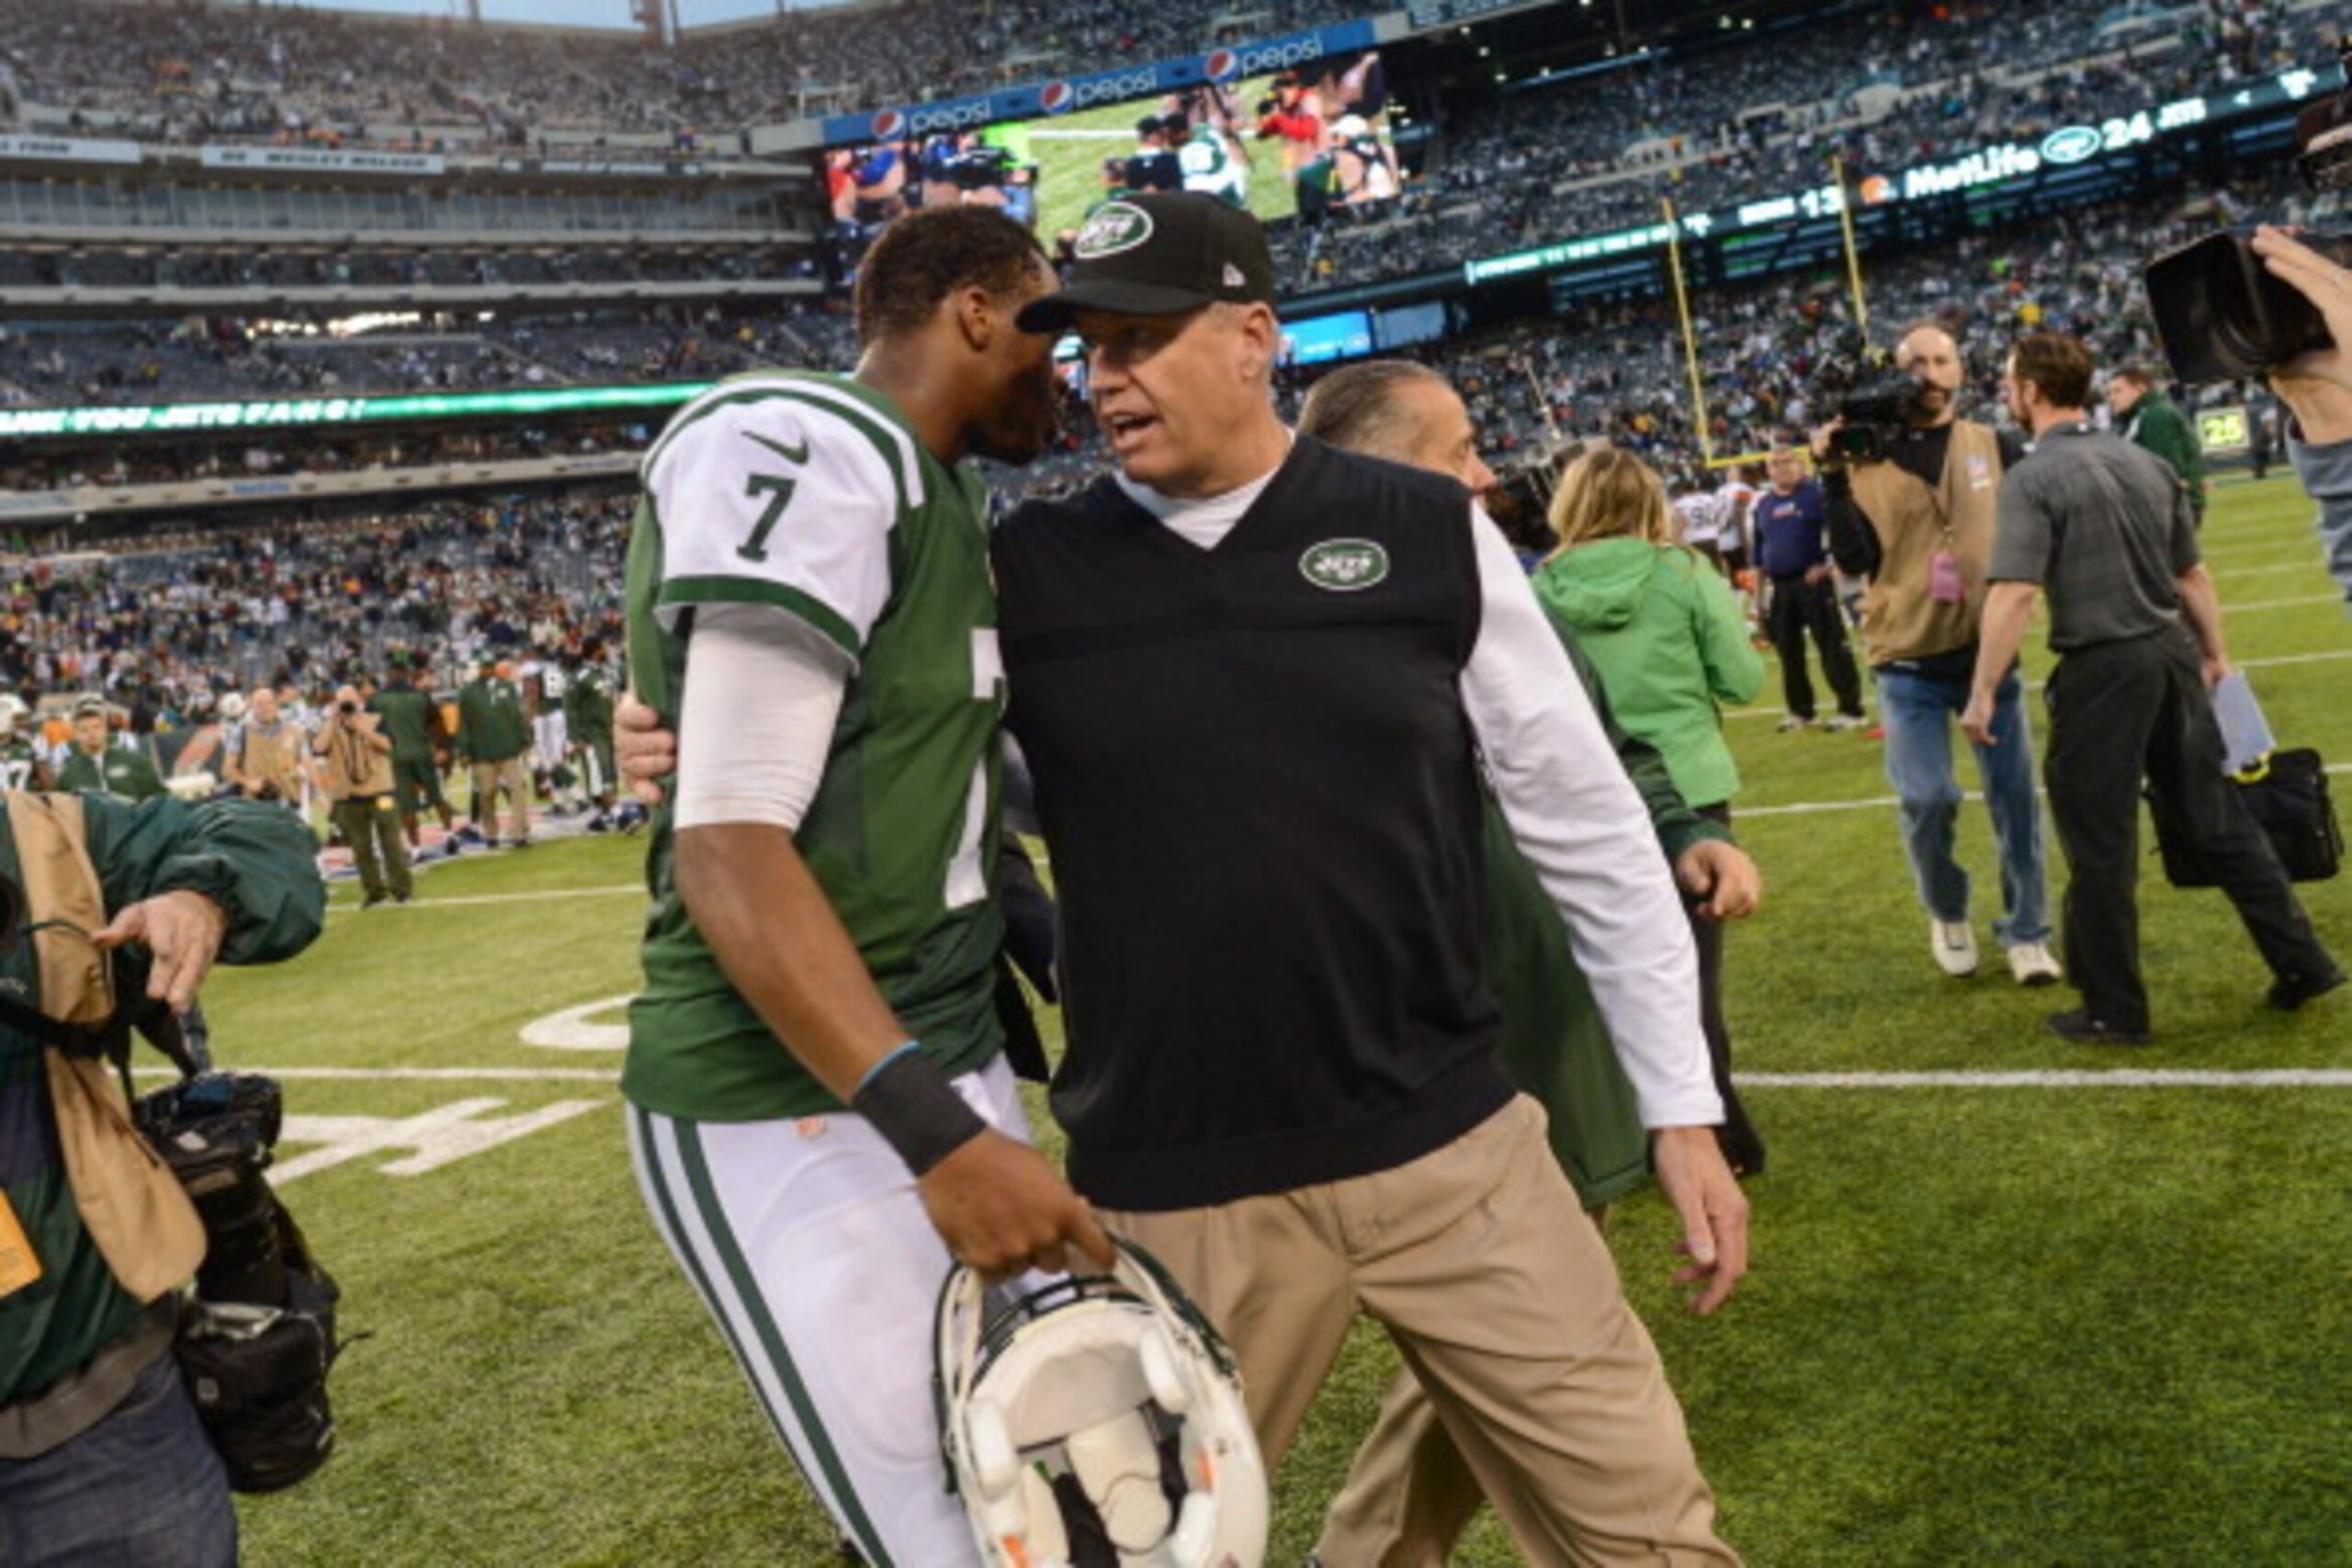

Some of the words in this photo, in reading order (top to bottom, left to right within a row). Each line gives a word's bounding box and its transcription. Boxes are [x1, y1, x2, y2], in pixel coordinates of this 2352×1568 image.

[910, 99, 991, 133] pepsi
[1076, 68, 1159, 107] pepsi
[1241, 35, 1324, 74] pepsi
[1801, 184, 1845, 218] 13
[1905, 142, 2041, 198] MetLife
[2098, 111, 2154, 149] 24
[74, 408, 151, 431] YOU
[2204, 414, 2245, 446] 25
[737, 473, 797, 562] 7
